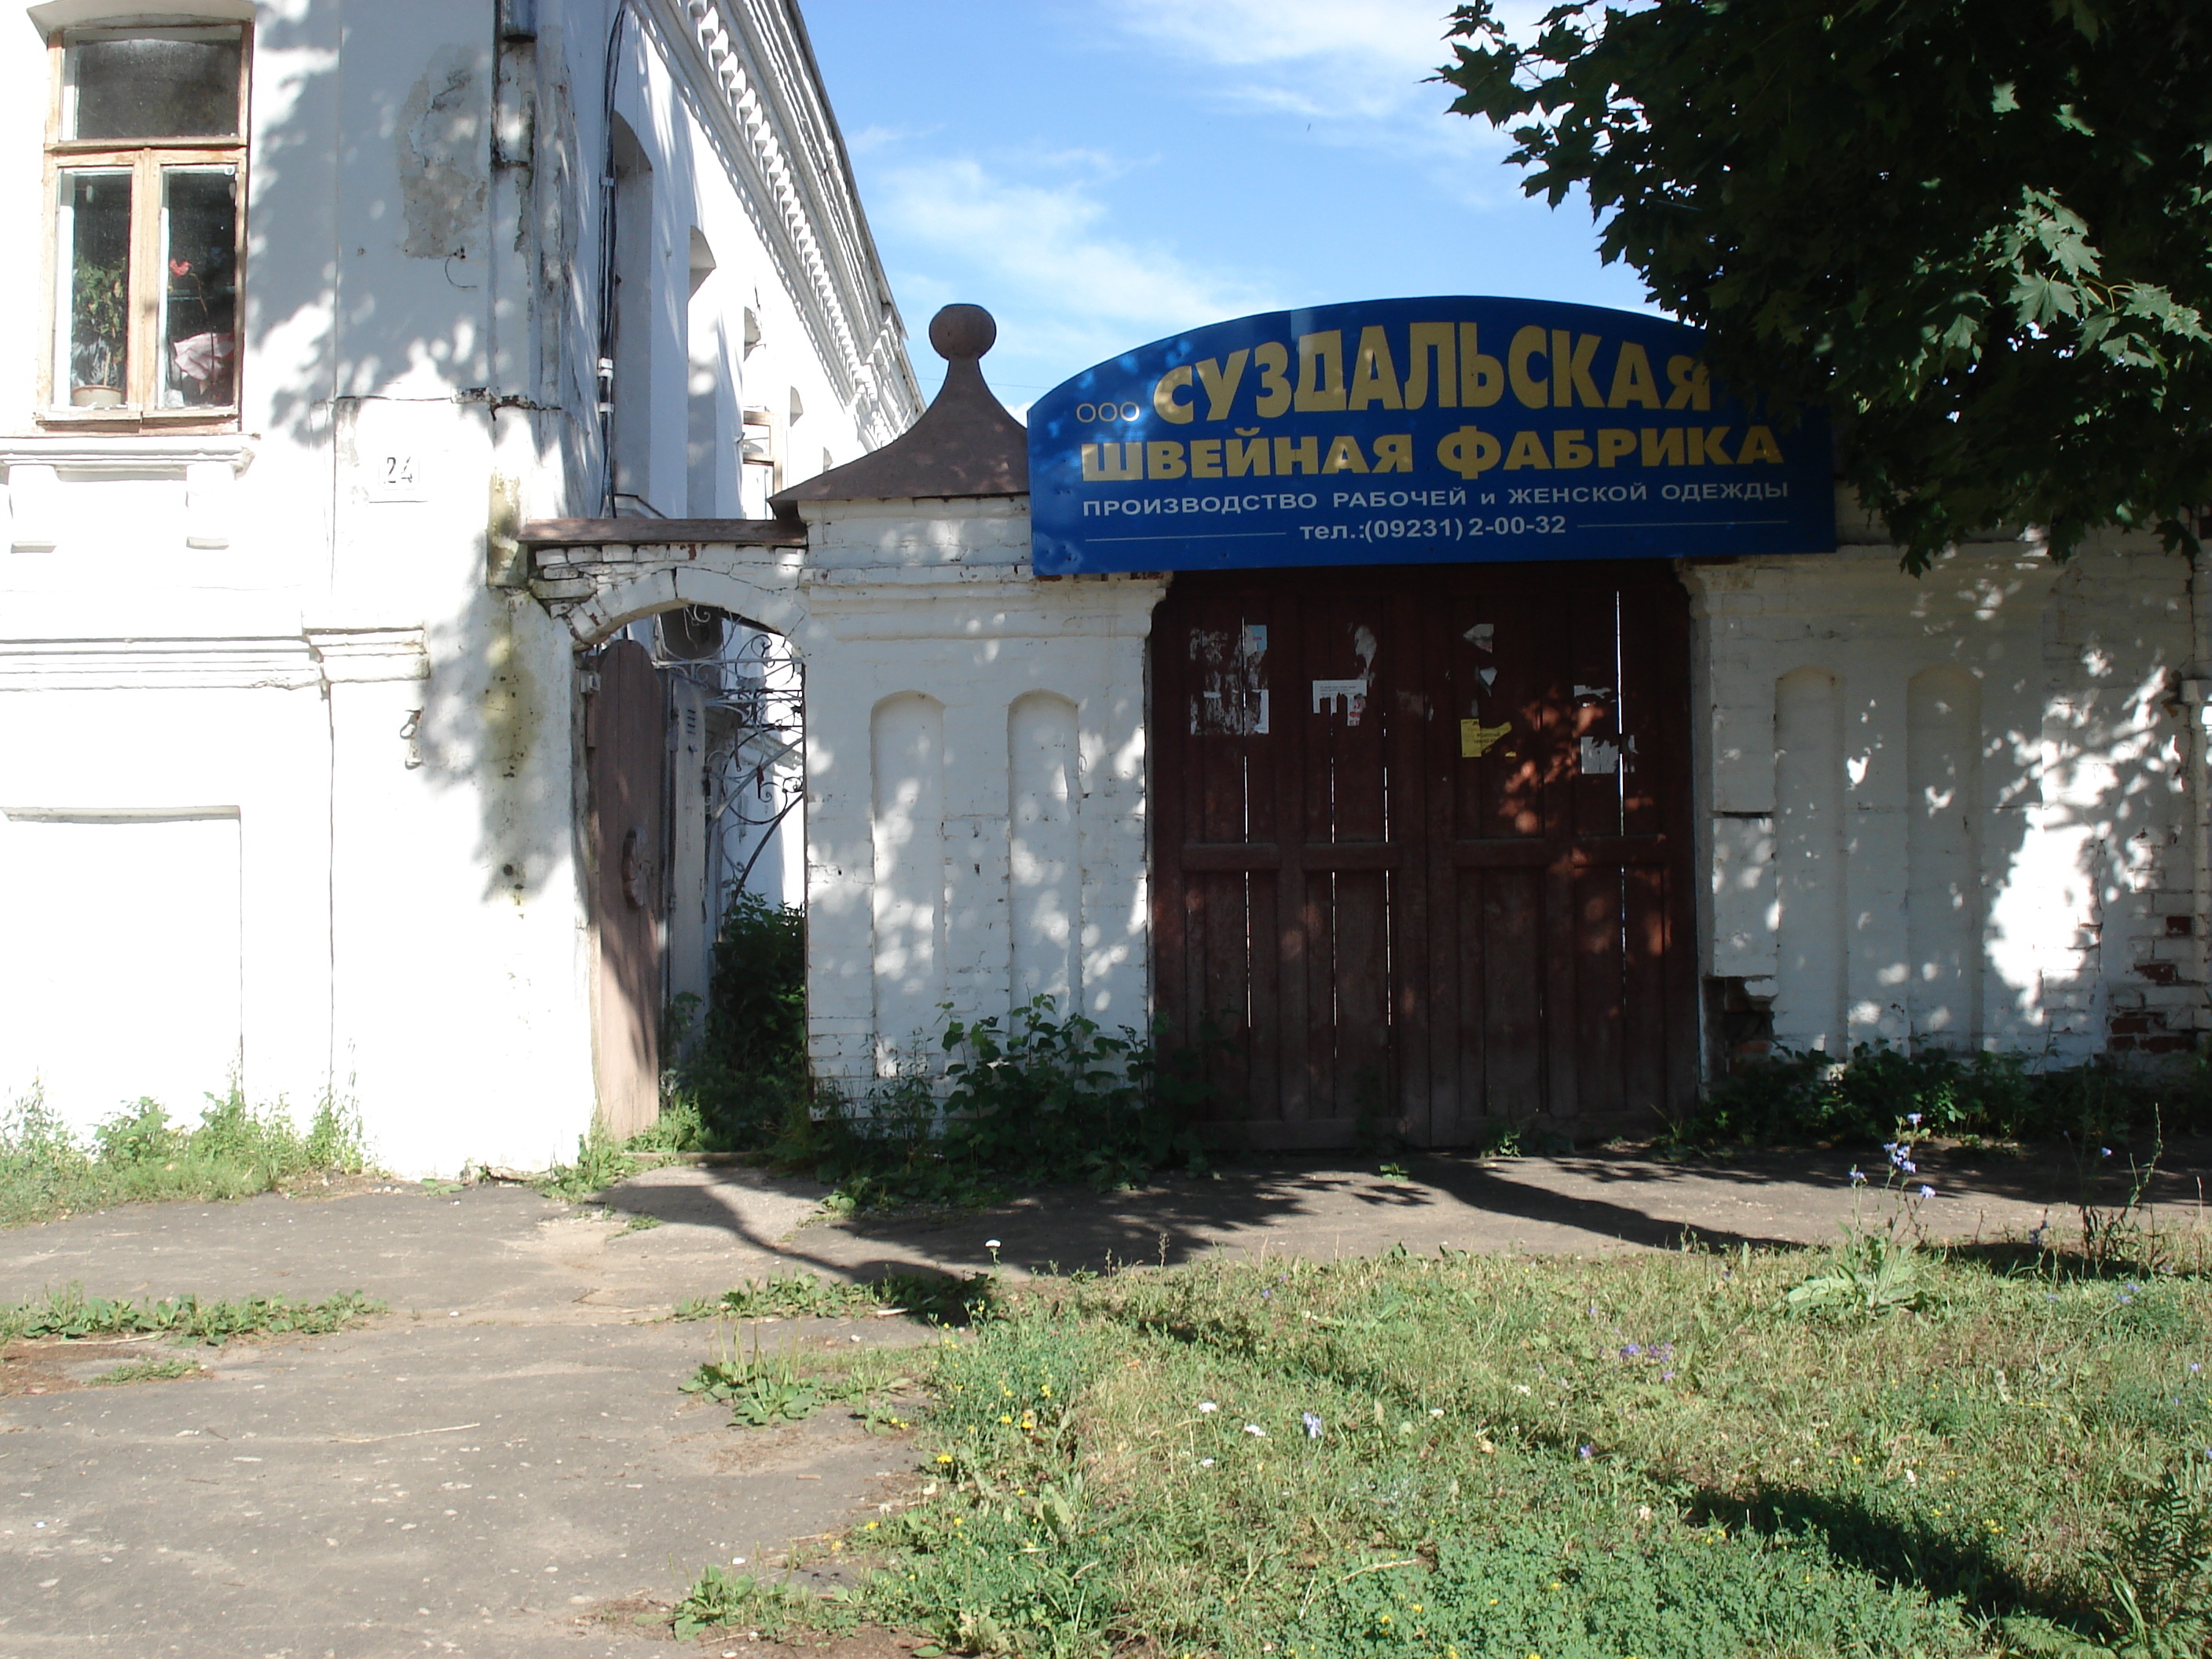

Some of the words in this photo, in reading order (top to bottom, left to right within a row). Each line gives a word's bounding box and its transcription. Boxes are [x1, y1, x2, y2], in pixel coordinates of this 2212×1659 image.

[1076, 401, 1141, 423] ООО
[1153, 322, 1711, 425] СУЗДАЛЬСКАЯ
[386, 456, 413, 484] 24
[1081, 427, 1414, 482] ШВЕЙНАЯ
[1436, 425, 1785, 480] ФАБРИКА
[1082, 493, 1318, 517] ПРОИЗВОДСТВО
[1333, 487, 1467, 508] РАБОЧЕЙ
[1481, 493, 1496, 505] и
[1507, 482, 1647, 504] ЖЕНСКОЙ
[1661, 482, 1789, 504] ОДЕЖДЫ
